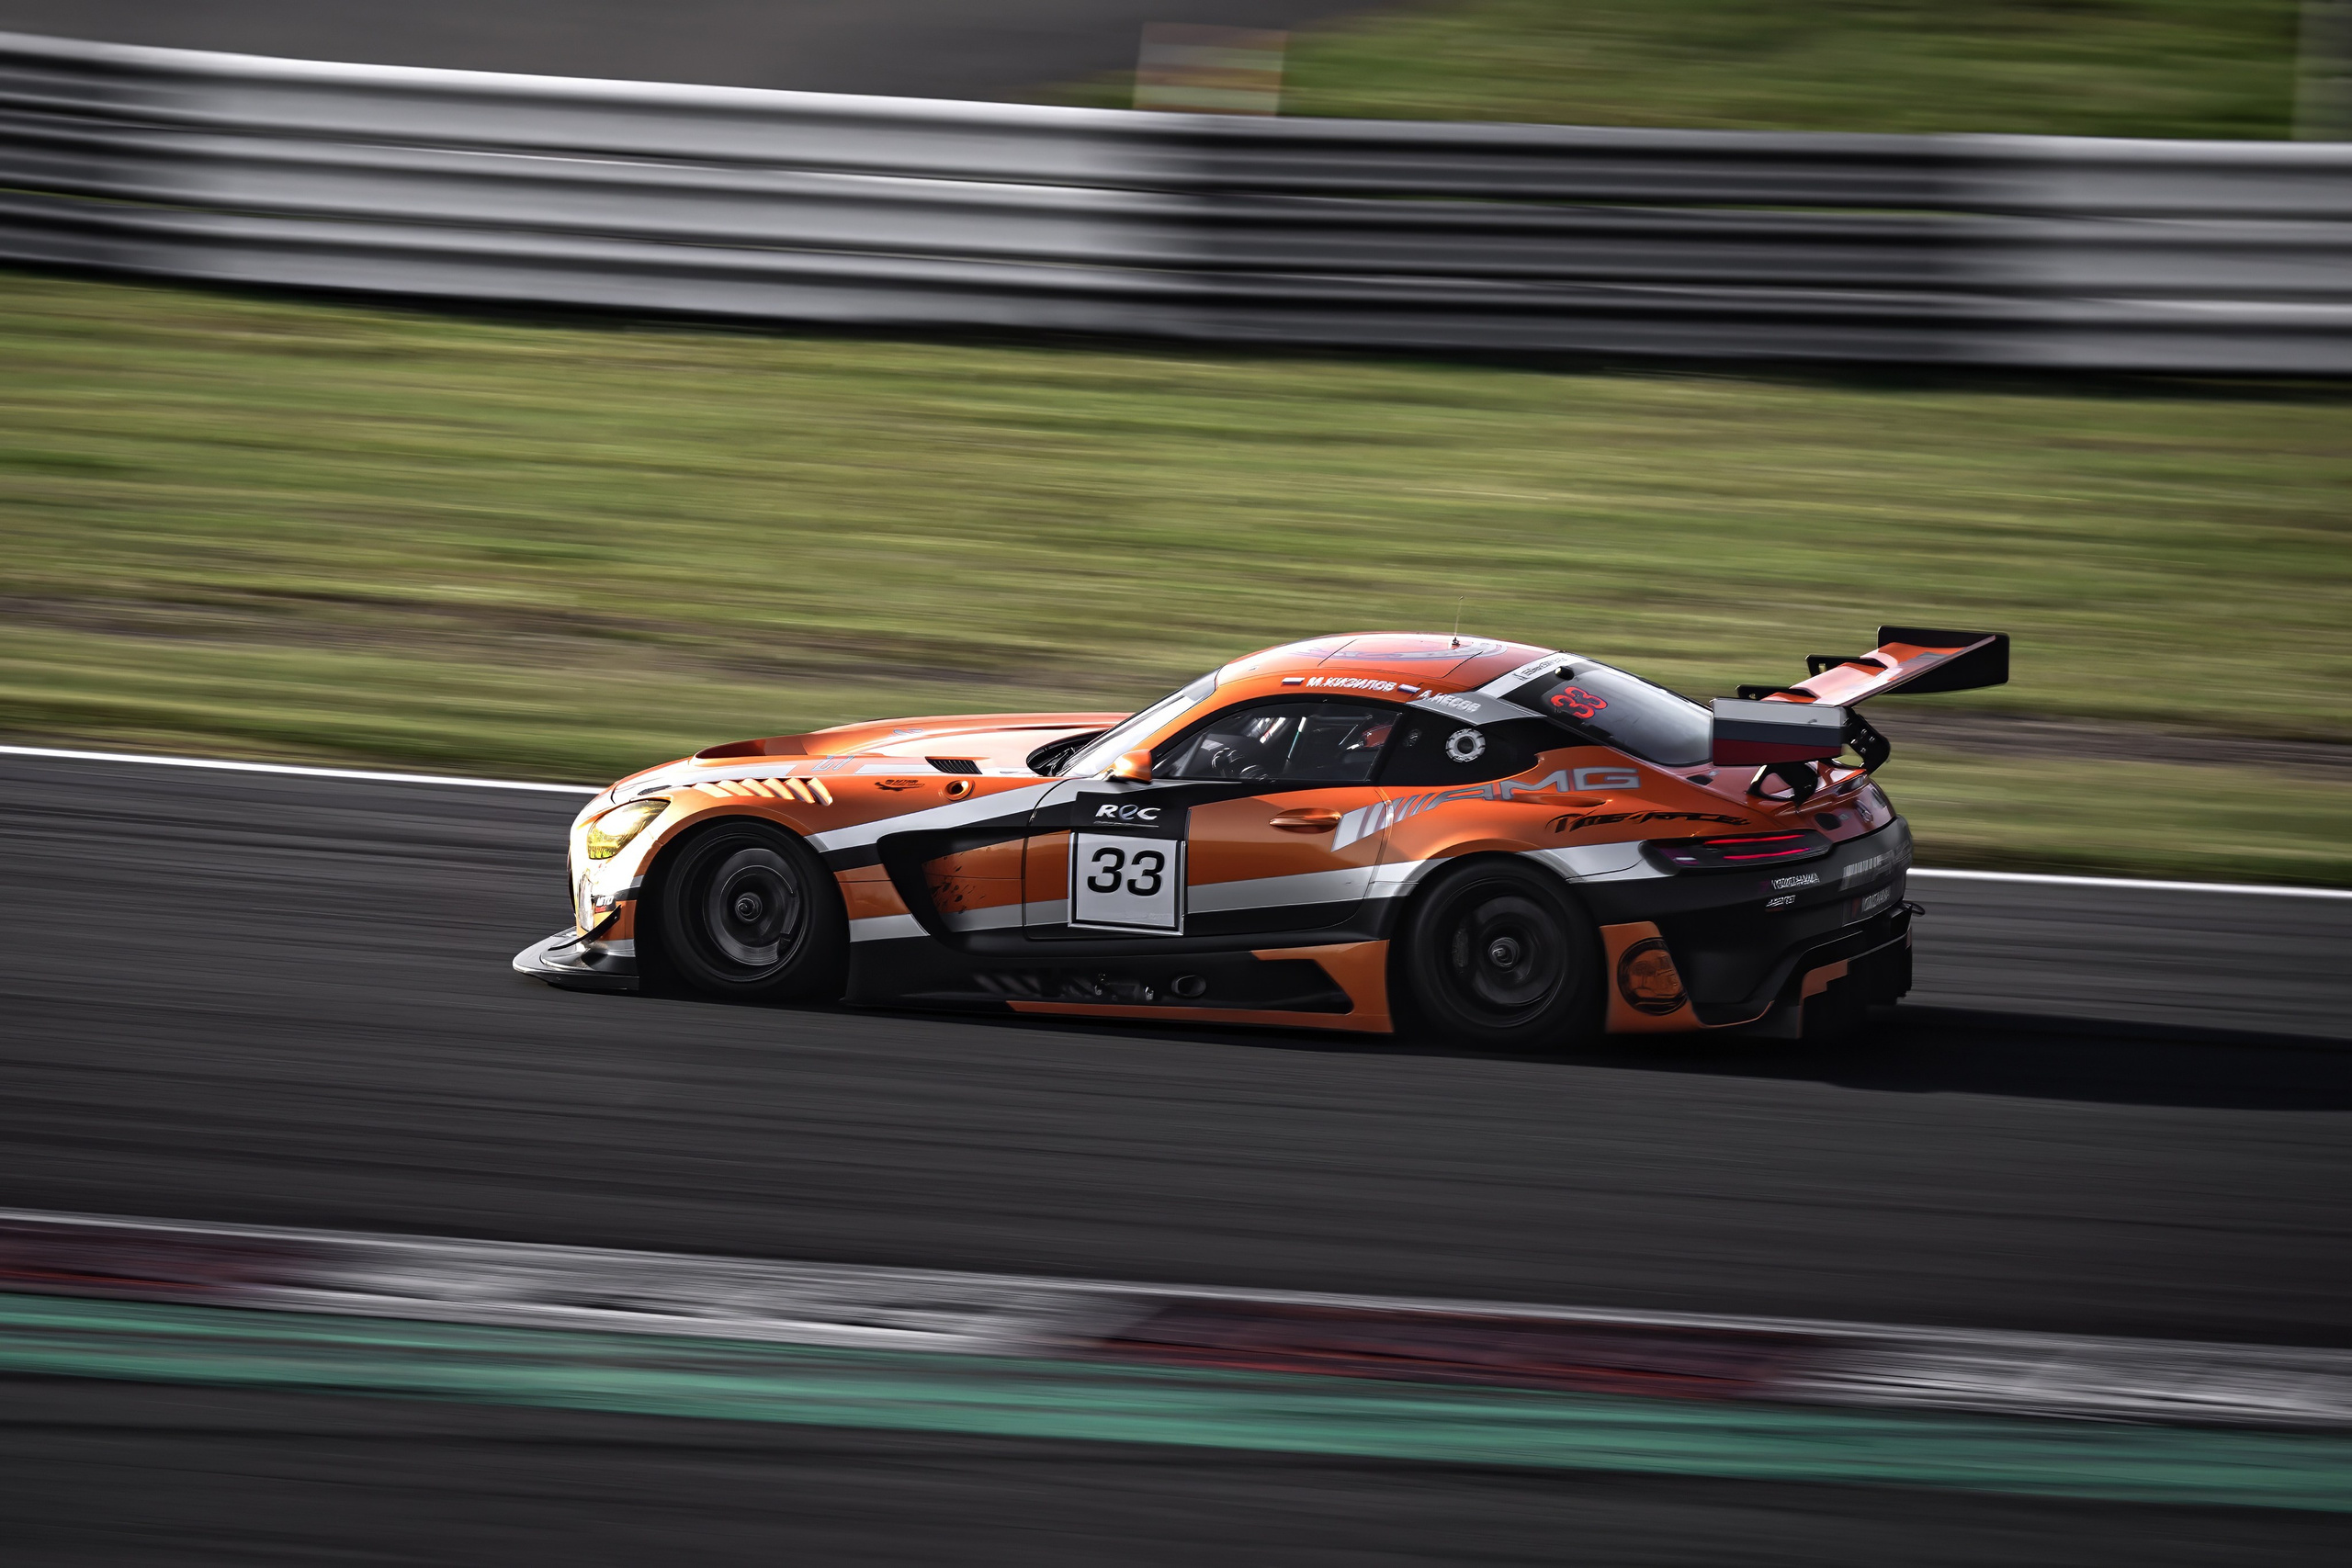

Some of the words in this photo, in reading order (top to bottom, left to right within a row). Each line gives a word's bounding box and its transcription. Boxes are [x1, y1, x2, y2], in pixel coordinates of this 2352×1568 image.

[1550, 685, 1609, 720] 33
[1422, 766, 1641, 812] AMG
[1087, 846, 1166, 897] 33
